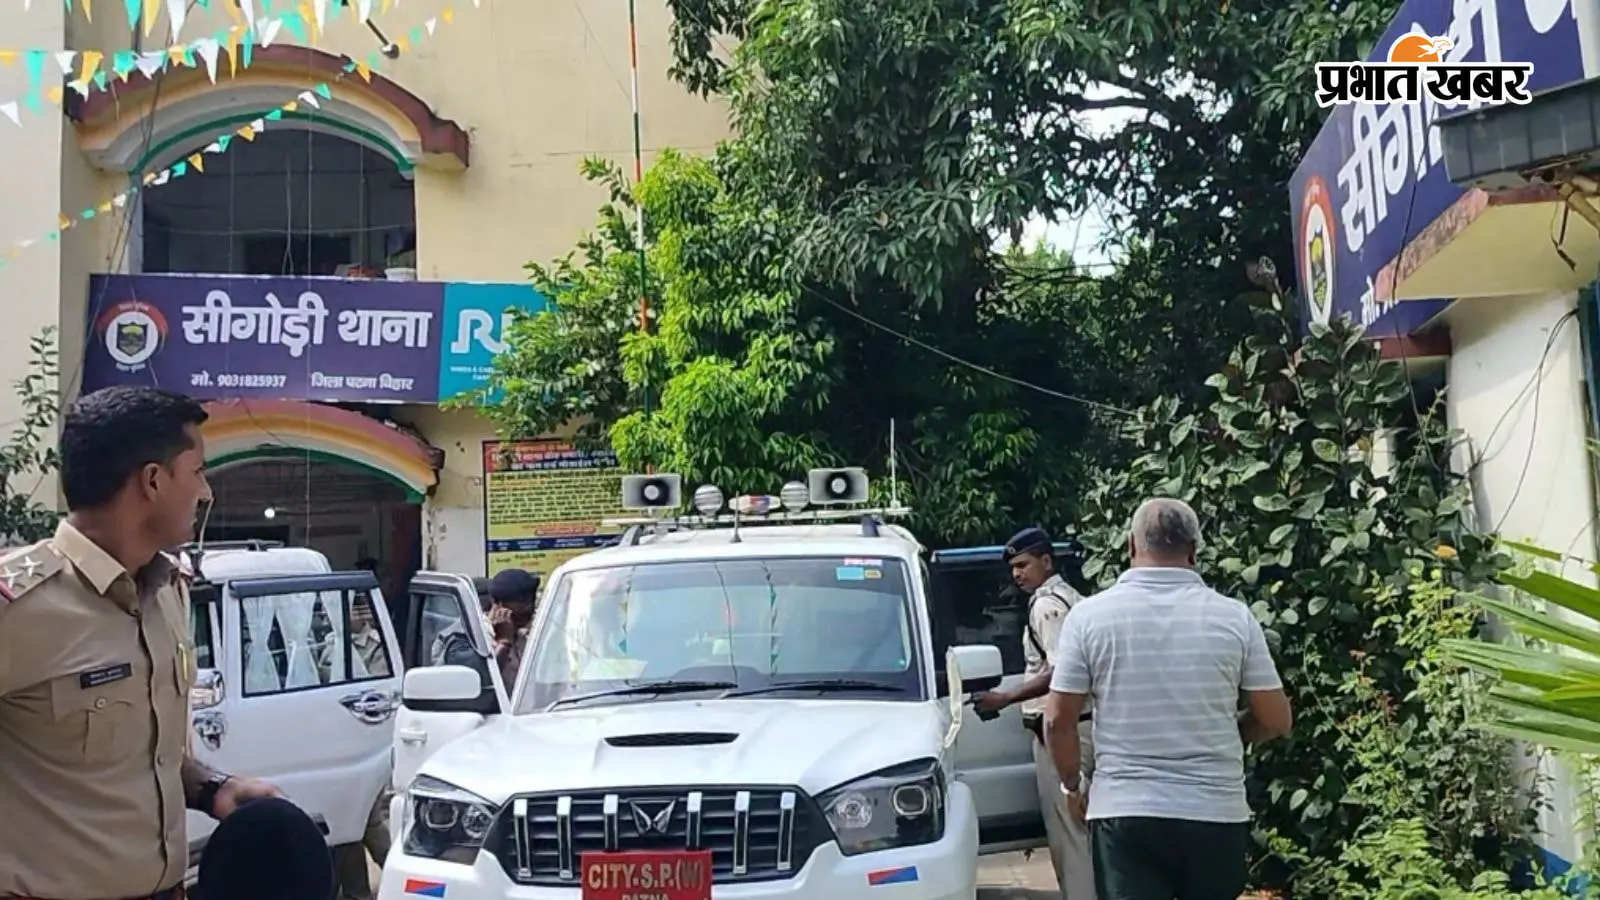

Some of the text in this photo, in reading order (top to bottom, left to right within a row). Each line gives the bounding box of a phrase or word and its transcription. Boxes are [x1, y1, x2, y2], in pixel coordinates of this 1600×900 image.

[181, 289, 433, 358] सीगोड़ी थाना
[217, 374, 287, 388] 9031825937
[311, 371, 344, 389] जिला
[346, 376, 377, 389] पटना
[379, 373, 414, 391] बिहार
